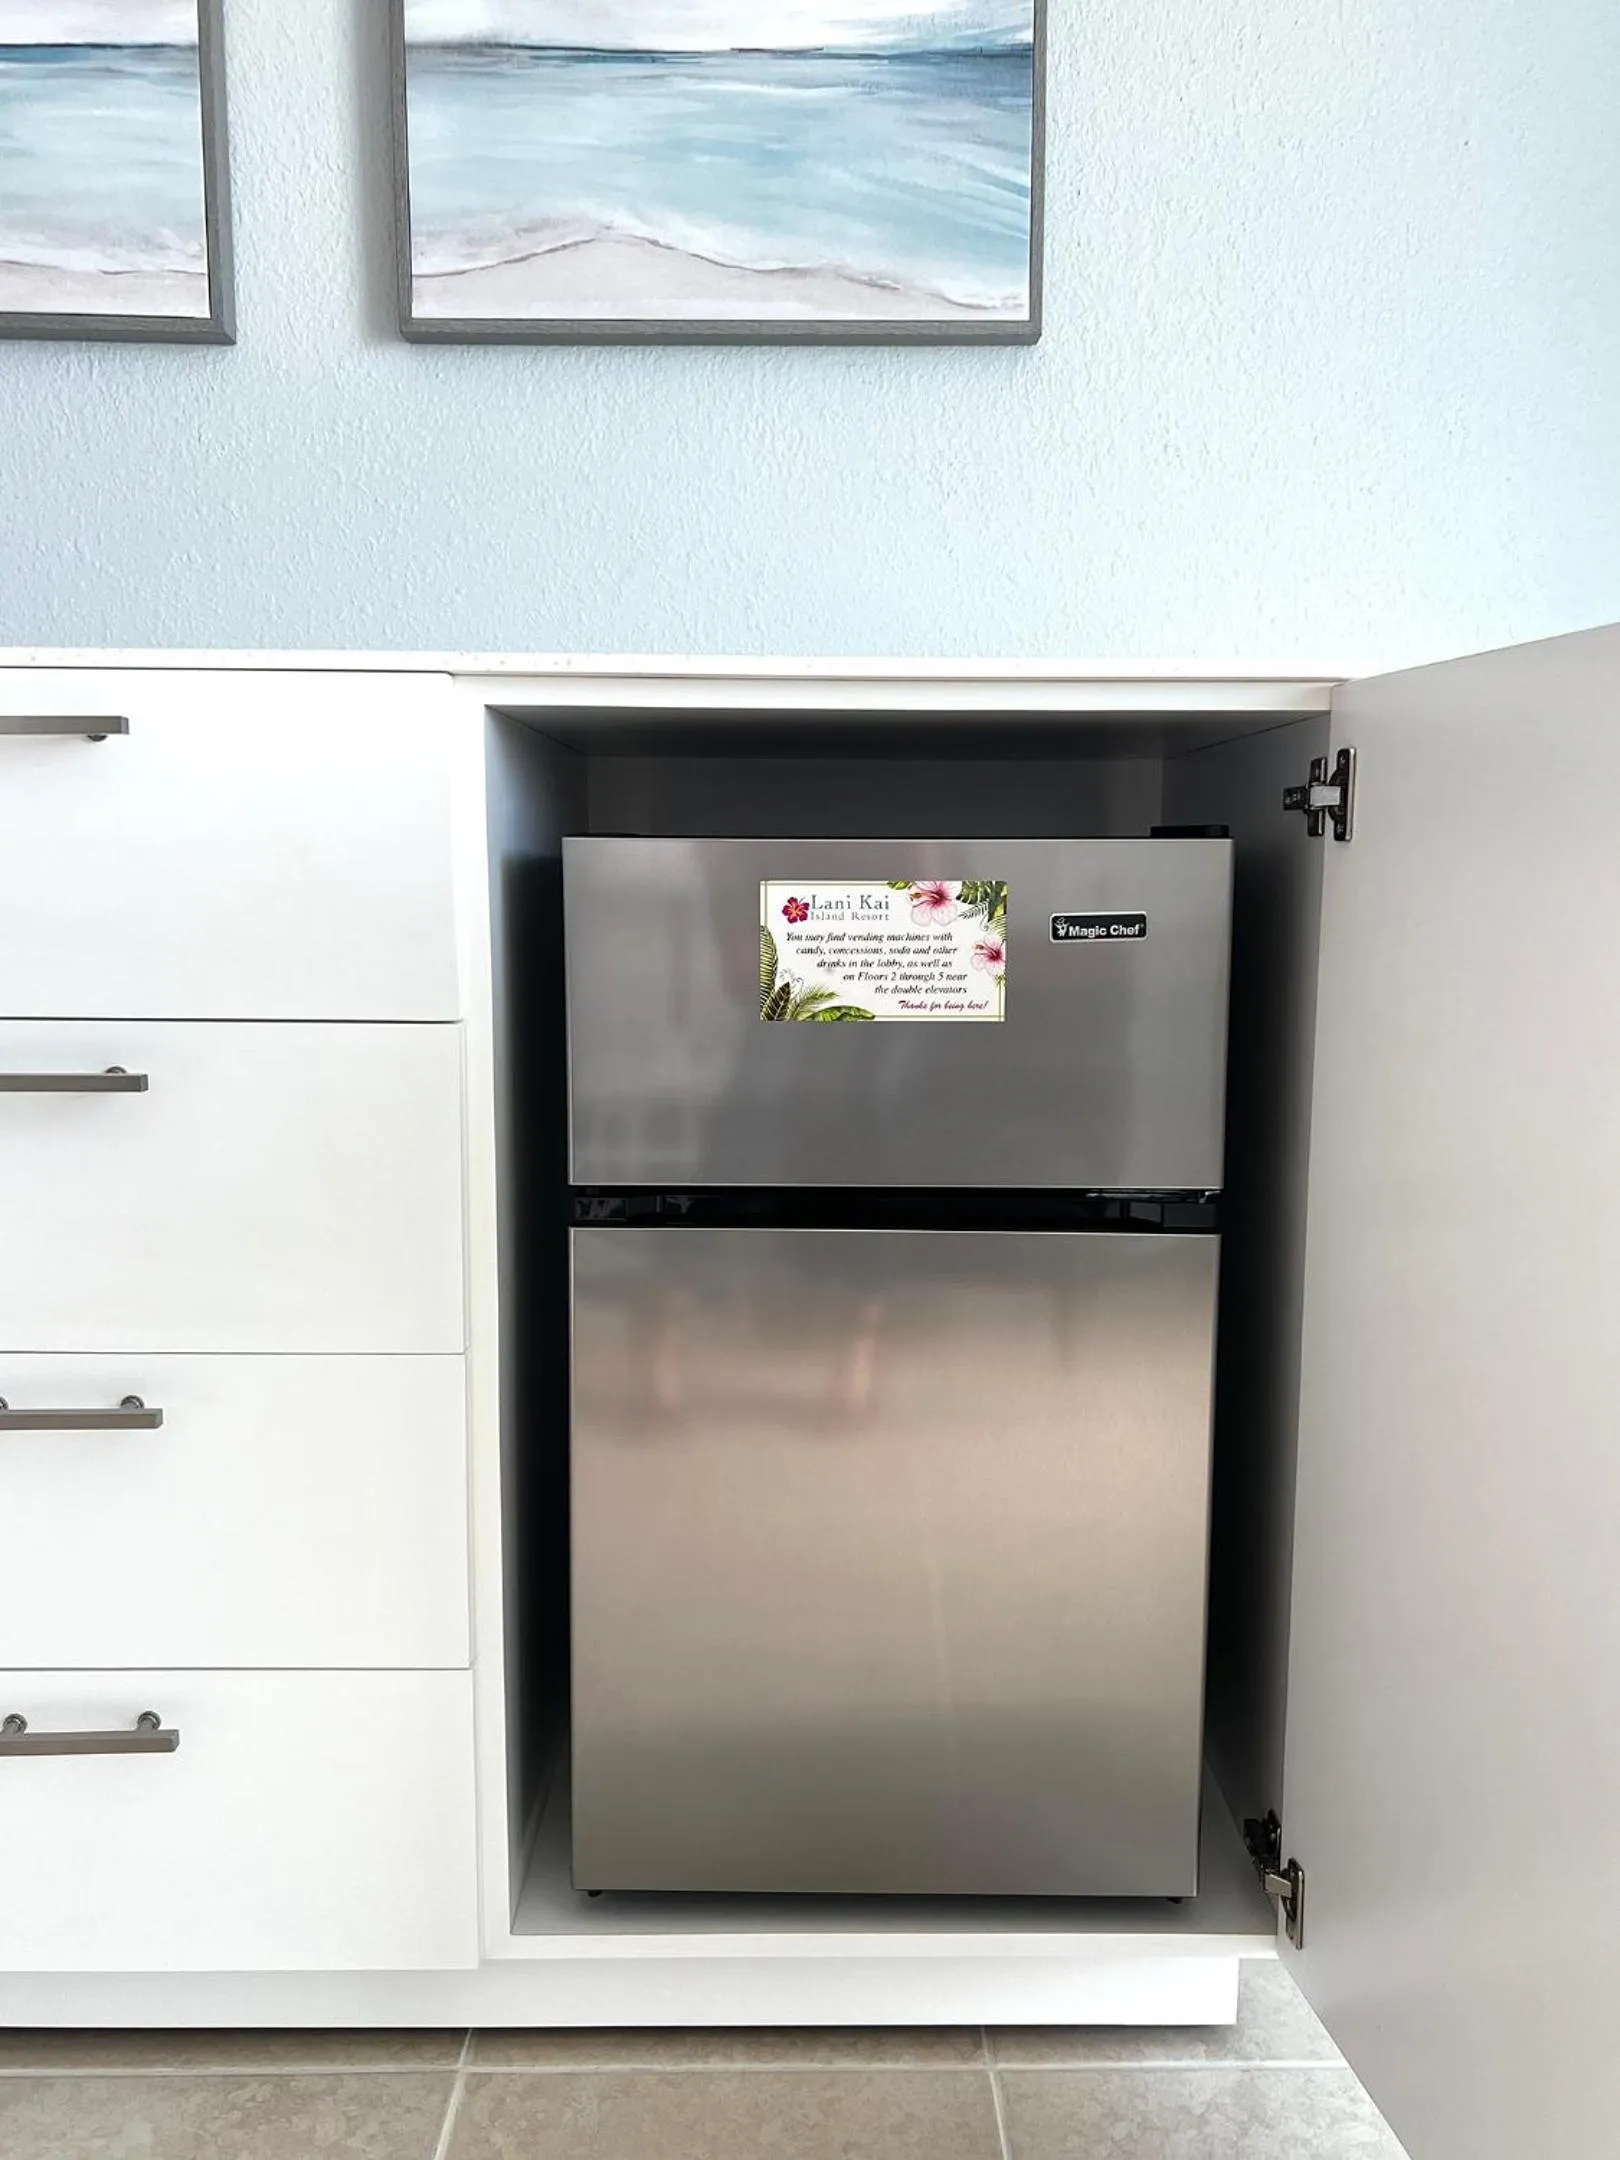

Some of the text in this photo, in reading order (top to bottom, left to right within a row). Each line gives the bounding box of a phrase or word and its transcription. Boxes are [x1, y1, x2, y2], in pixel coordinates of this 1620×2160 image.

[811, 894, 889, 910] Lani Kai
[811, 911, 889, 921] Island Resort
[1068, 924, 1139, 938] Magic Chef
[786, 932, 953, 943] You may find vending machines with
[796, 946, 958, 956] candy, concessions, soda and other
[817, 959, 846, 968] drinks
[848, 959, 858, 967] in
[860, 959, 875, 967] the
[877, 959, 905, 970] lobby,
[920, 959, 939, 968] well
[857, 972, 888, 981] Floors
[890, 972, 897, 981] 2
[899, 972, 936, 982] through
[937, 972, 944, 981] 5
[874, 985, 967, 994] the double elevators
[898, 1000, 988, 1012] Thanks for being here!
